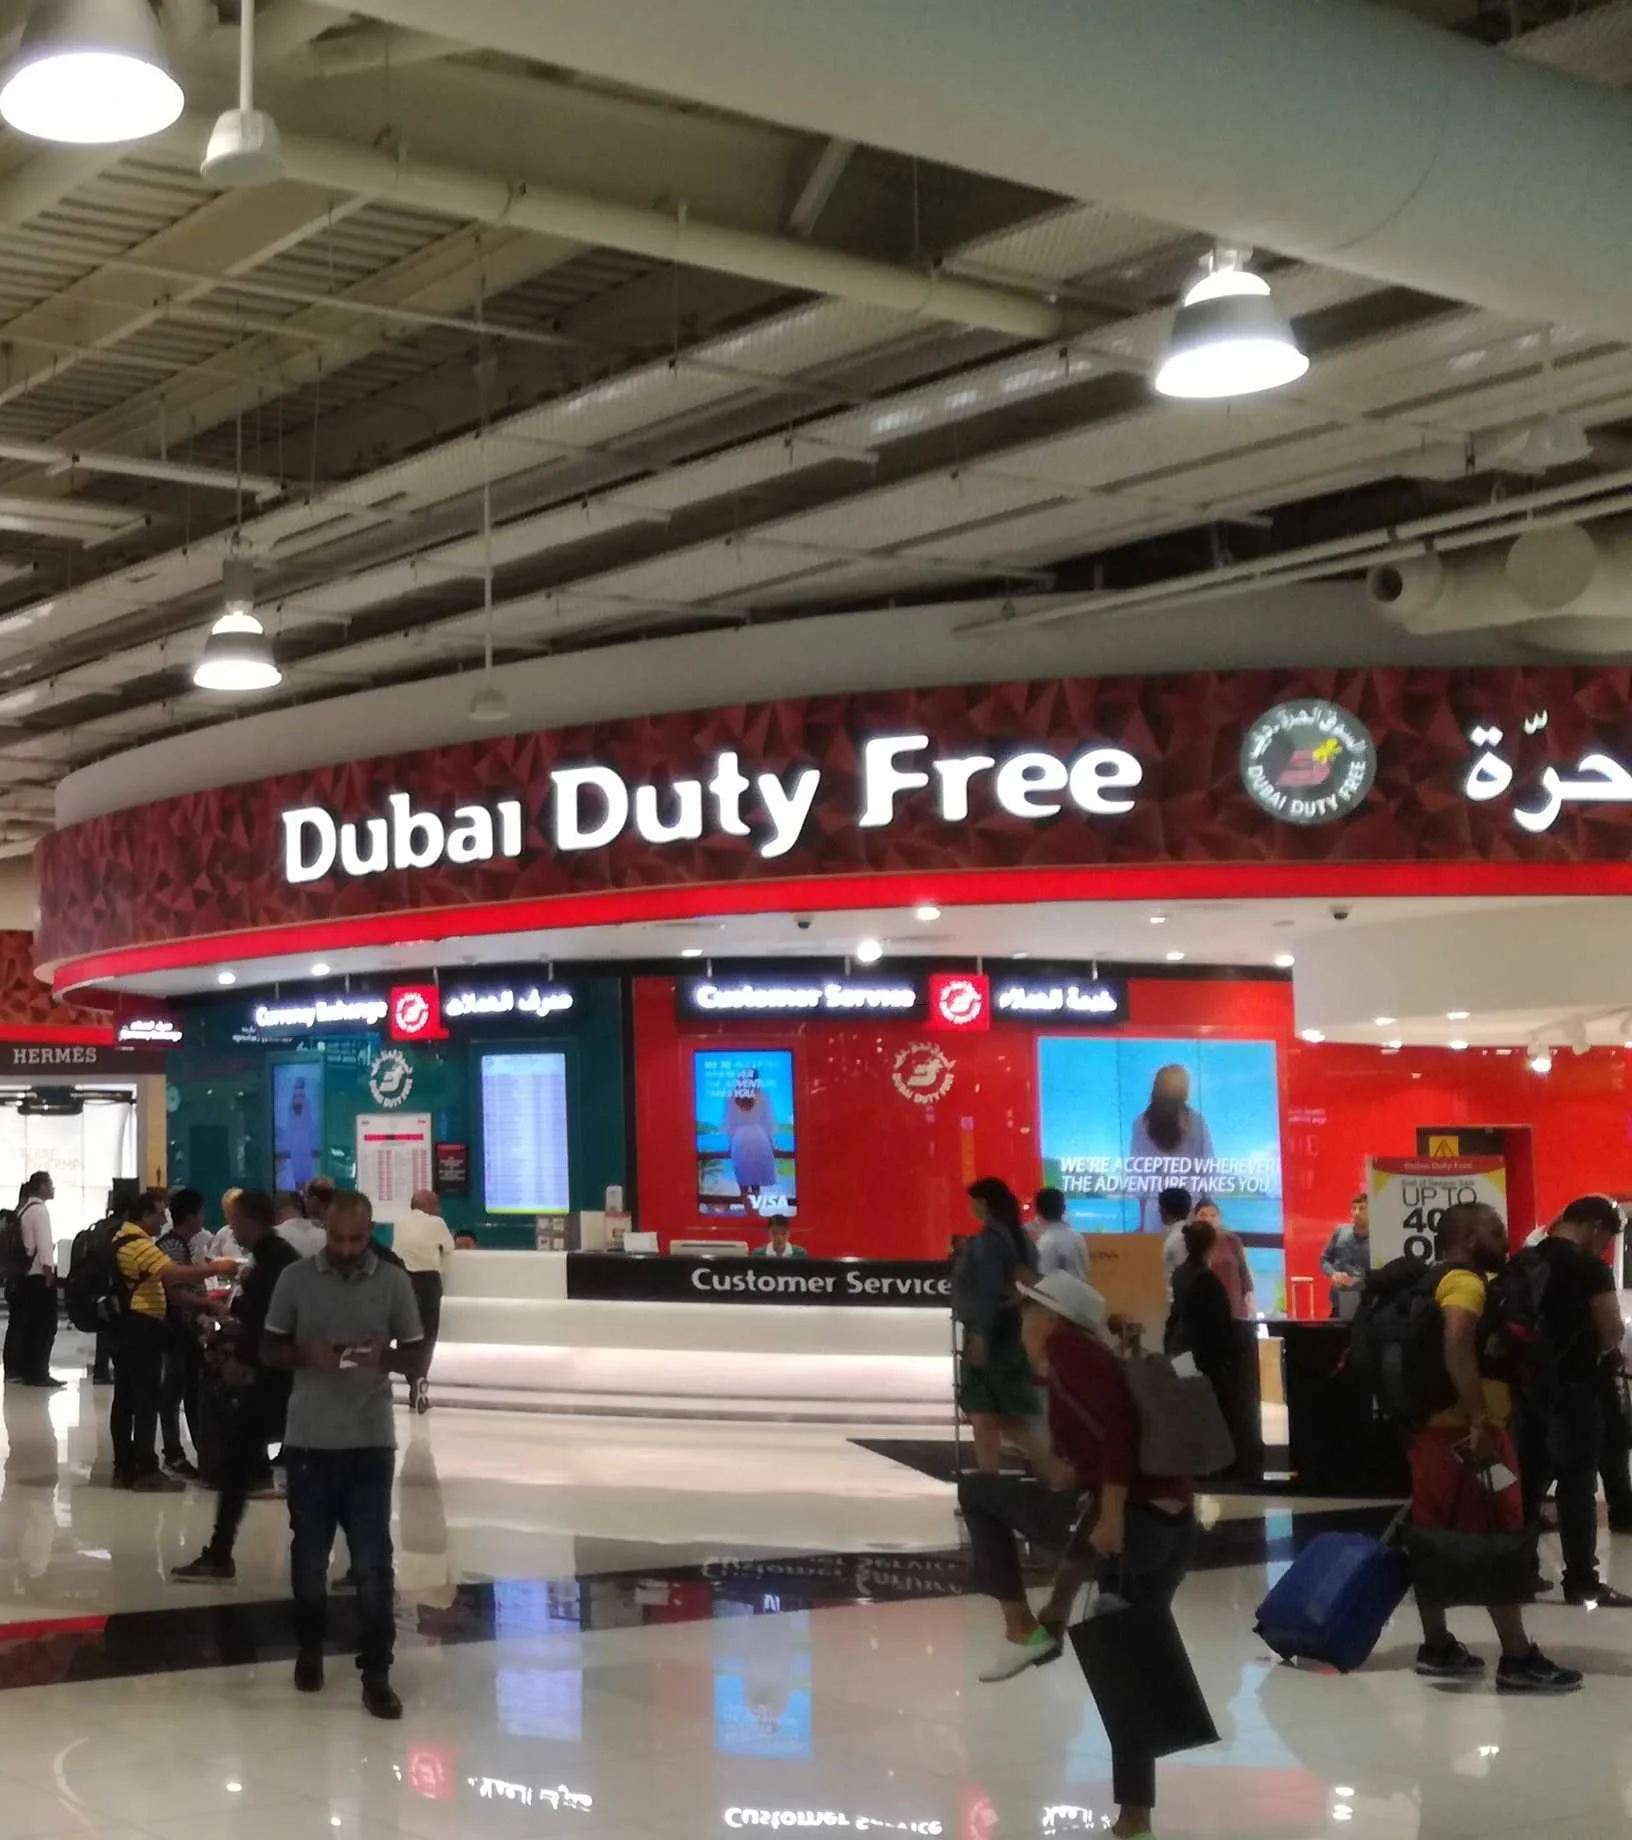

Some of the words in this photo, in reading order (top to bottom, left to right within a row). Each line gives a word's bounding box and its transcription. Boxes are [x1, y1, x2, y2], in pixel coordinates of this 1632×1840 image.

[1248, 765, 1287, 810] DUBAI
[1290, 794, 1338, 817] DUTY
[1338, 761, 1366, 801] FREE
[282, 792, 521, 885] Dubai
[551, 750, 820, 858] Duty
[857, 734, 1144, 828] Free
[1112, 1157, 1191, 1173] ACCEPTED
[1194, 1157, 1275, 1174] WHEREVER
[1062, 1175, 1093, 1192] THE
[1095, 1175, 1187, 1192] ADVENTURE
[1190, 1175, 1235, 1193] TAKES
[748, 1194, 789, 1209] VISA
[1402, 1187, 1437, 1206] UP
[1442, 1186, 1477, 1207] TO
[691, 1267, 837, 1293] Customer
[847, 1271, 953, 1294] Service
